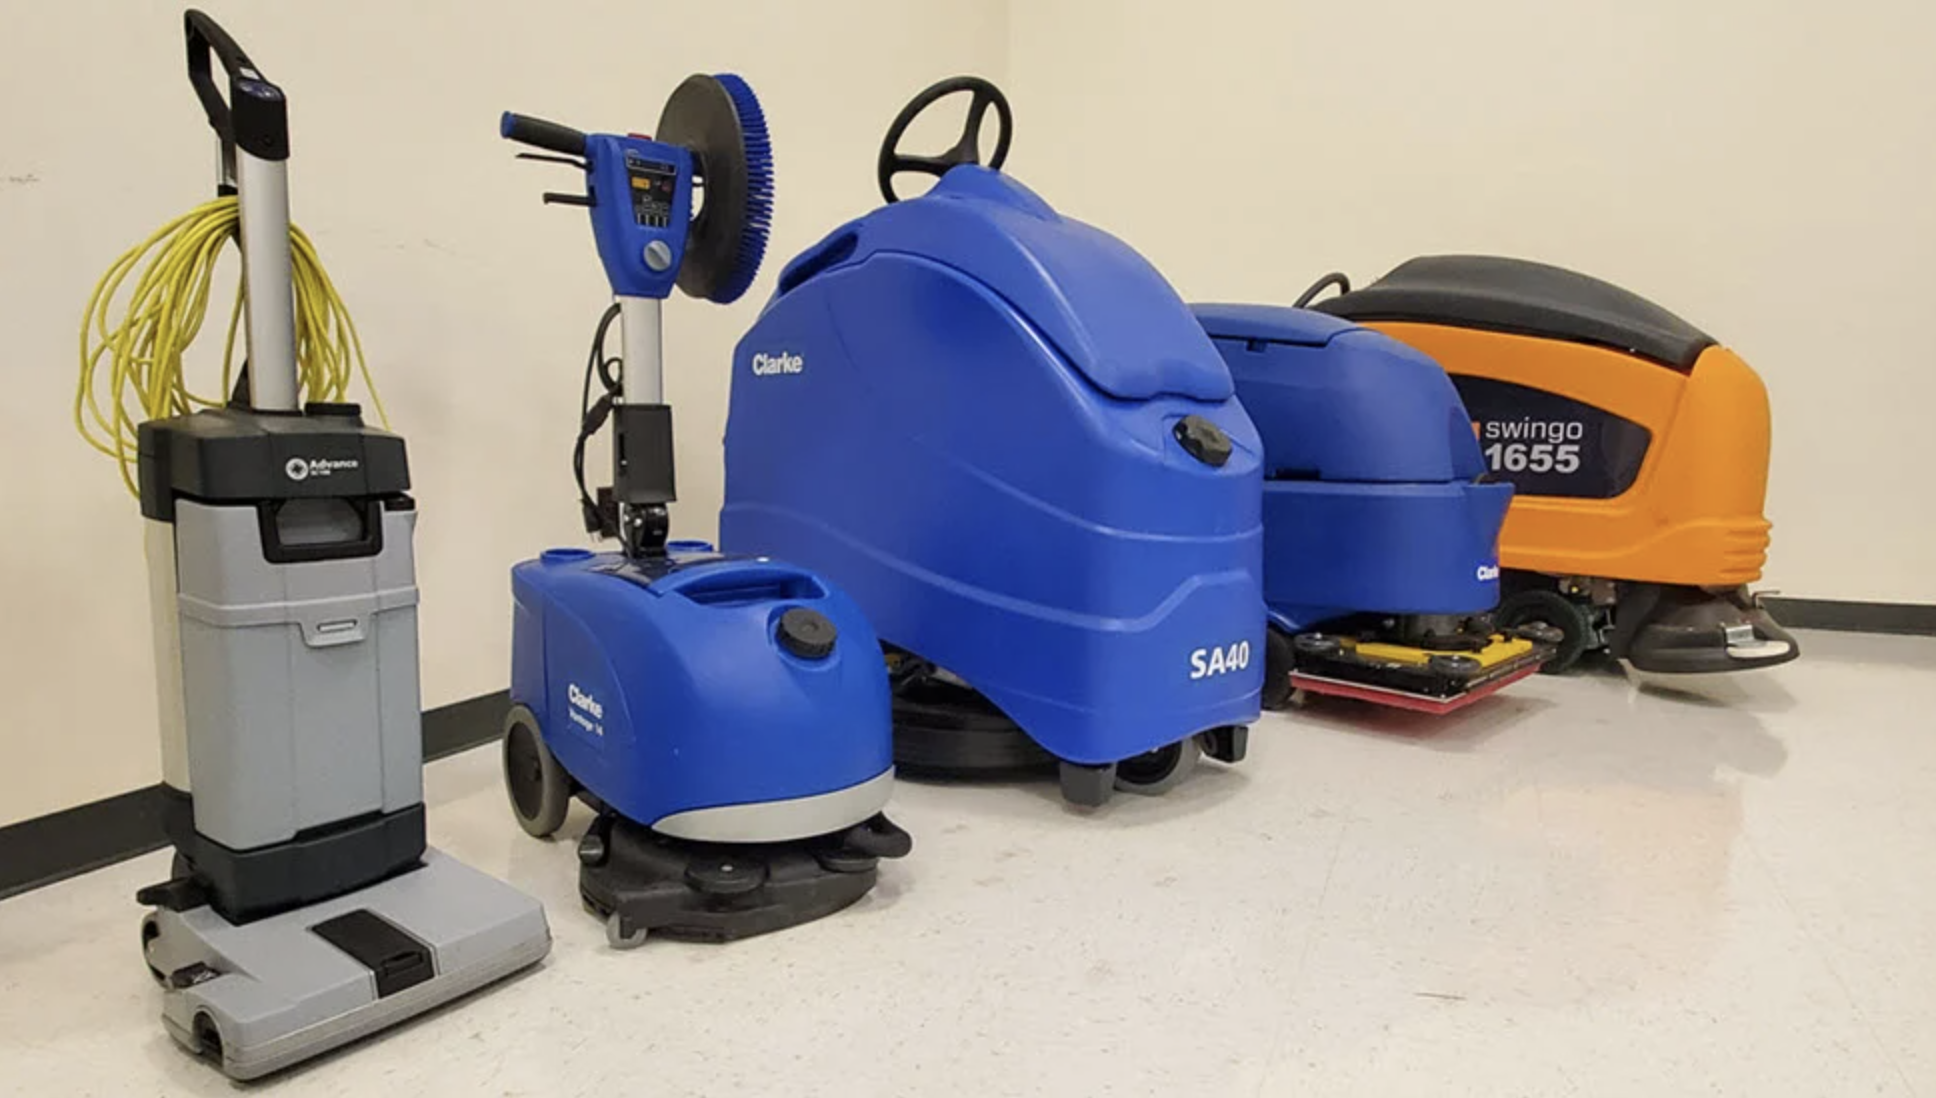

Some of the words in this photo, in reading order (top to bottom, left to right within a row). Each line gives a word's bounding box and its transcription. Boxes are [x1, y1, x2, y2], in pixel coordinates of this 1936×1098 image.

[752, 352, 803, 375] Clarke
[1486, 416, 1583, 443] swingo
[309, 459, 358, 470] Advance
[1485, 443, 1580, 473] 1655
[1190, 640, 1249, 679] SA40
[568, 683, 603, 719] Clarke
